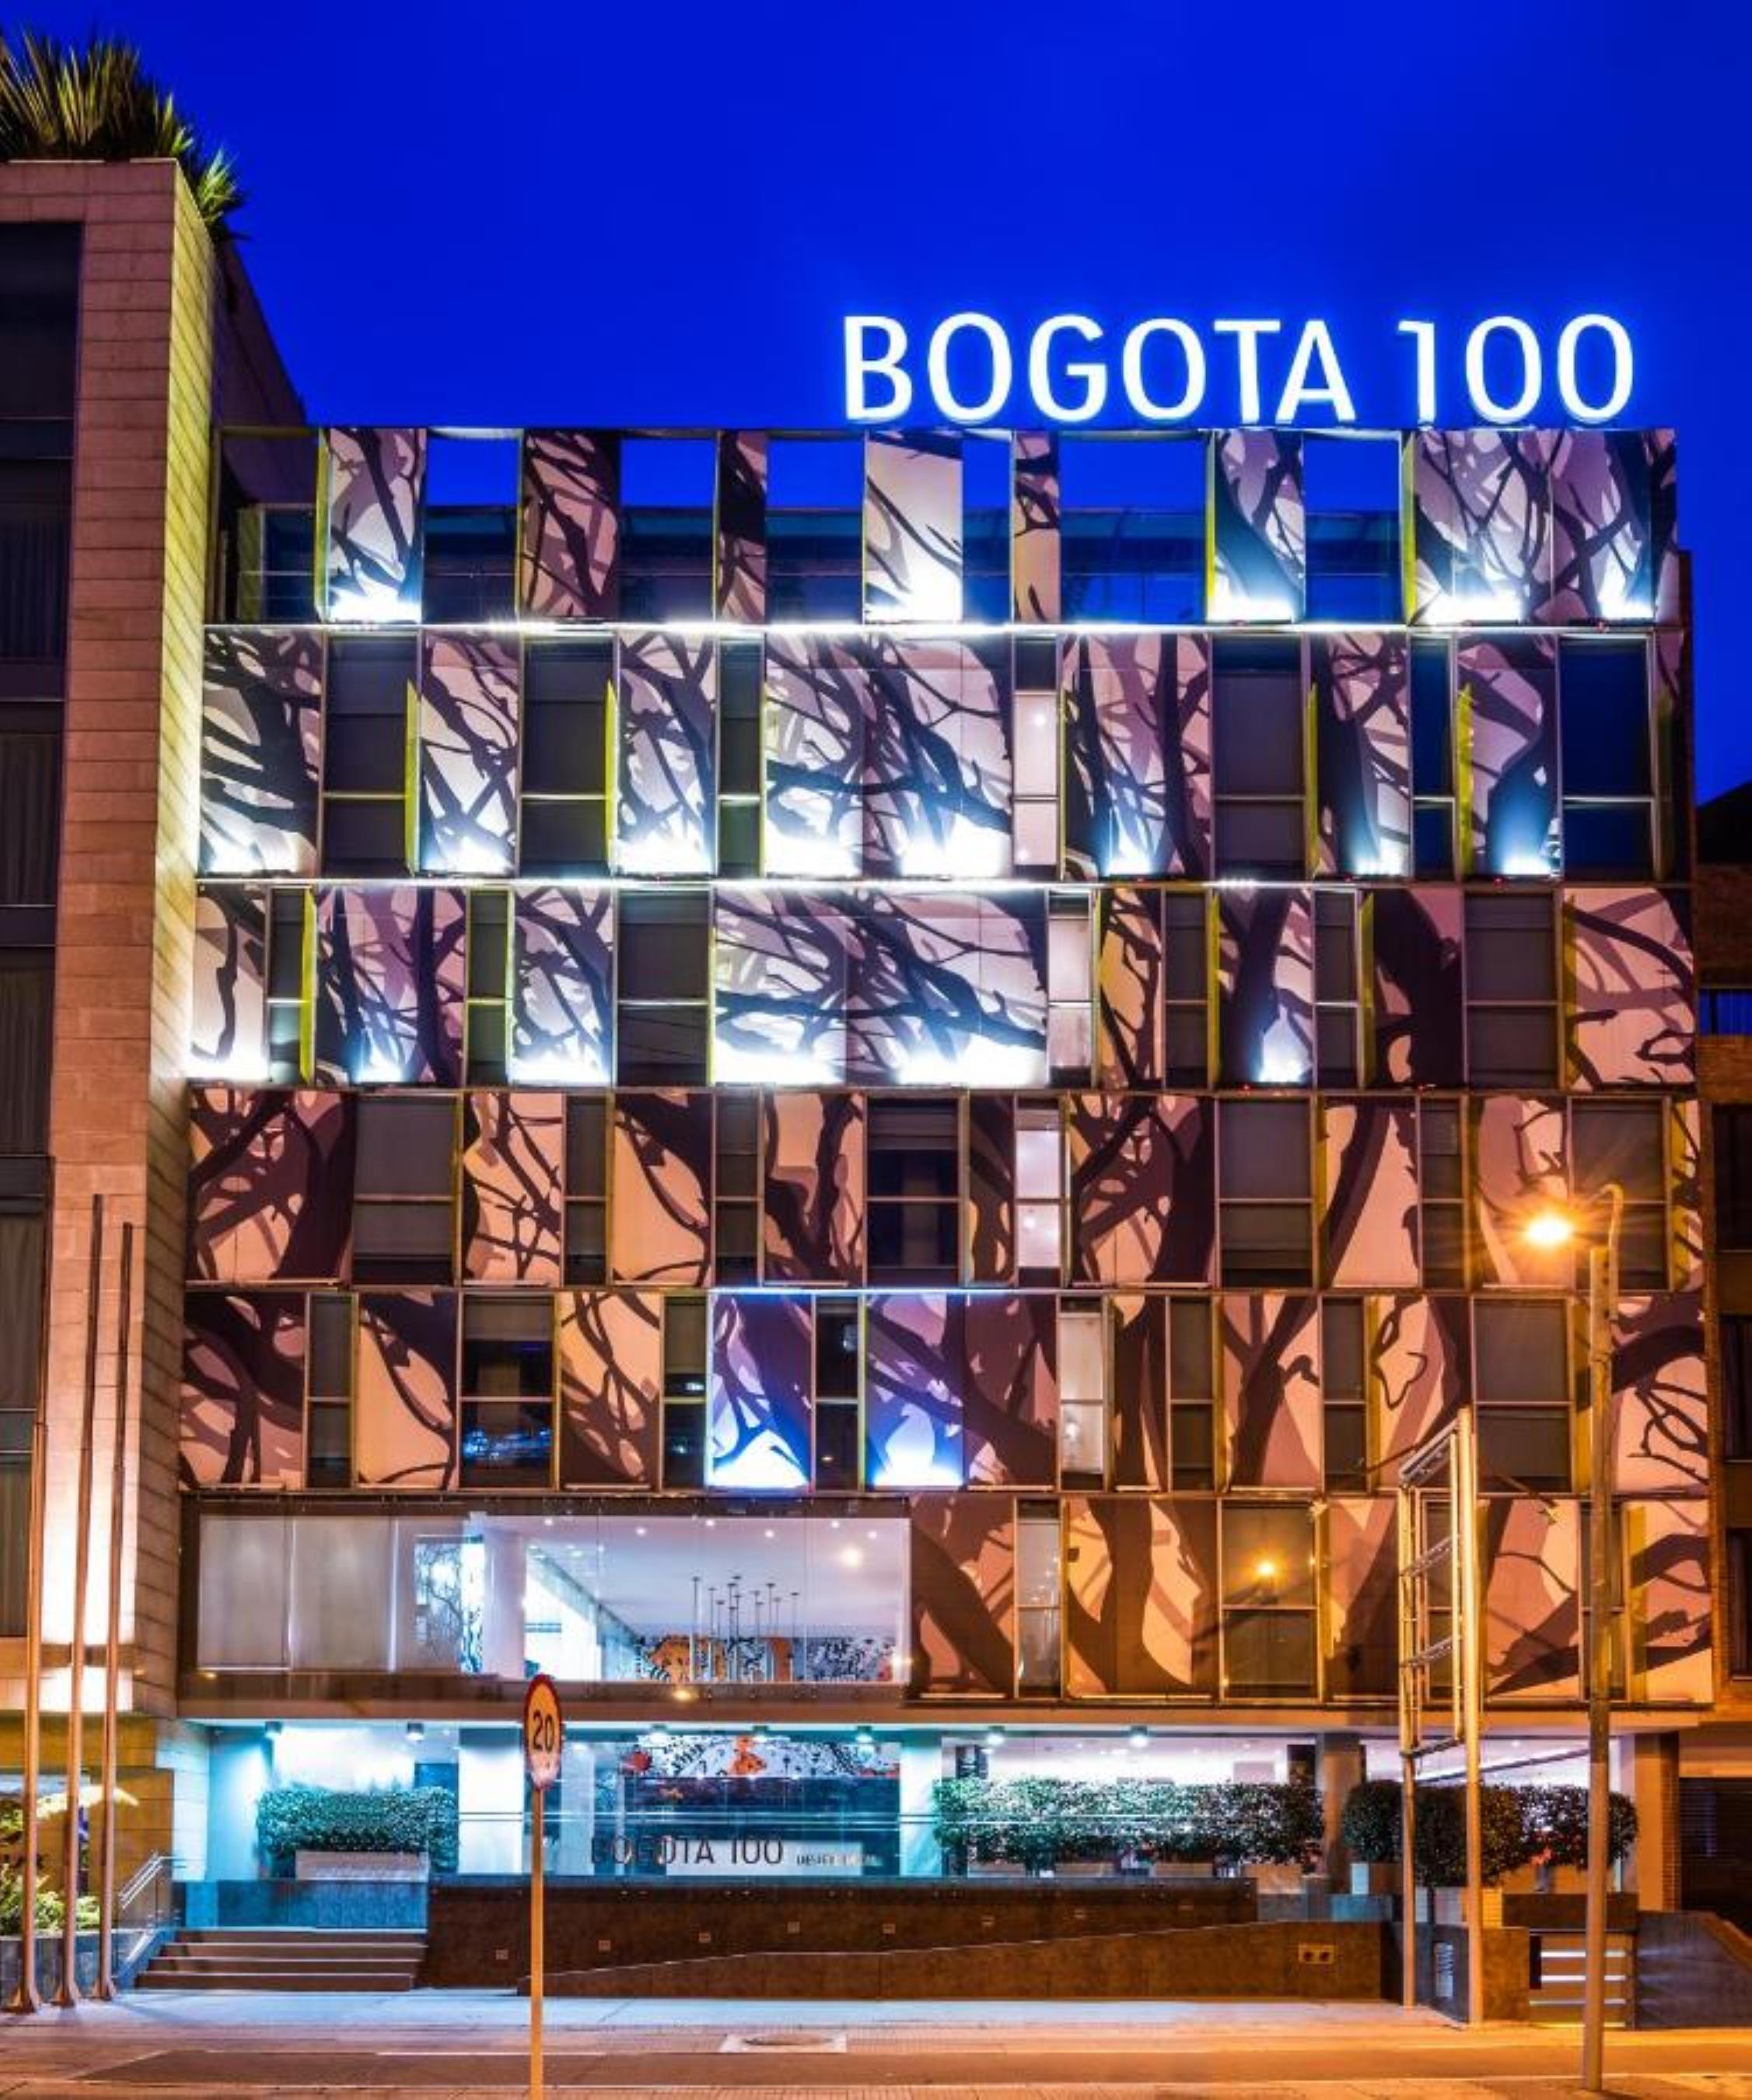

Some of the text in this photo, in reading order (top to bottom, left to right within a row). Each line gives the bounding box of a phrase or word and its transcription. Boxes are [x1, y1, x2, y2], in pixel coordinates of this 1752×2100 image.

[844, 312, 1634, 424] BOGOTA 100
[533, 1710, 554, 1752] 20
[731, 1834, 783, 1864] 100
